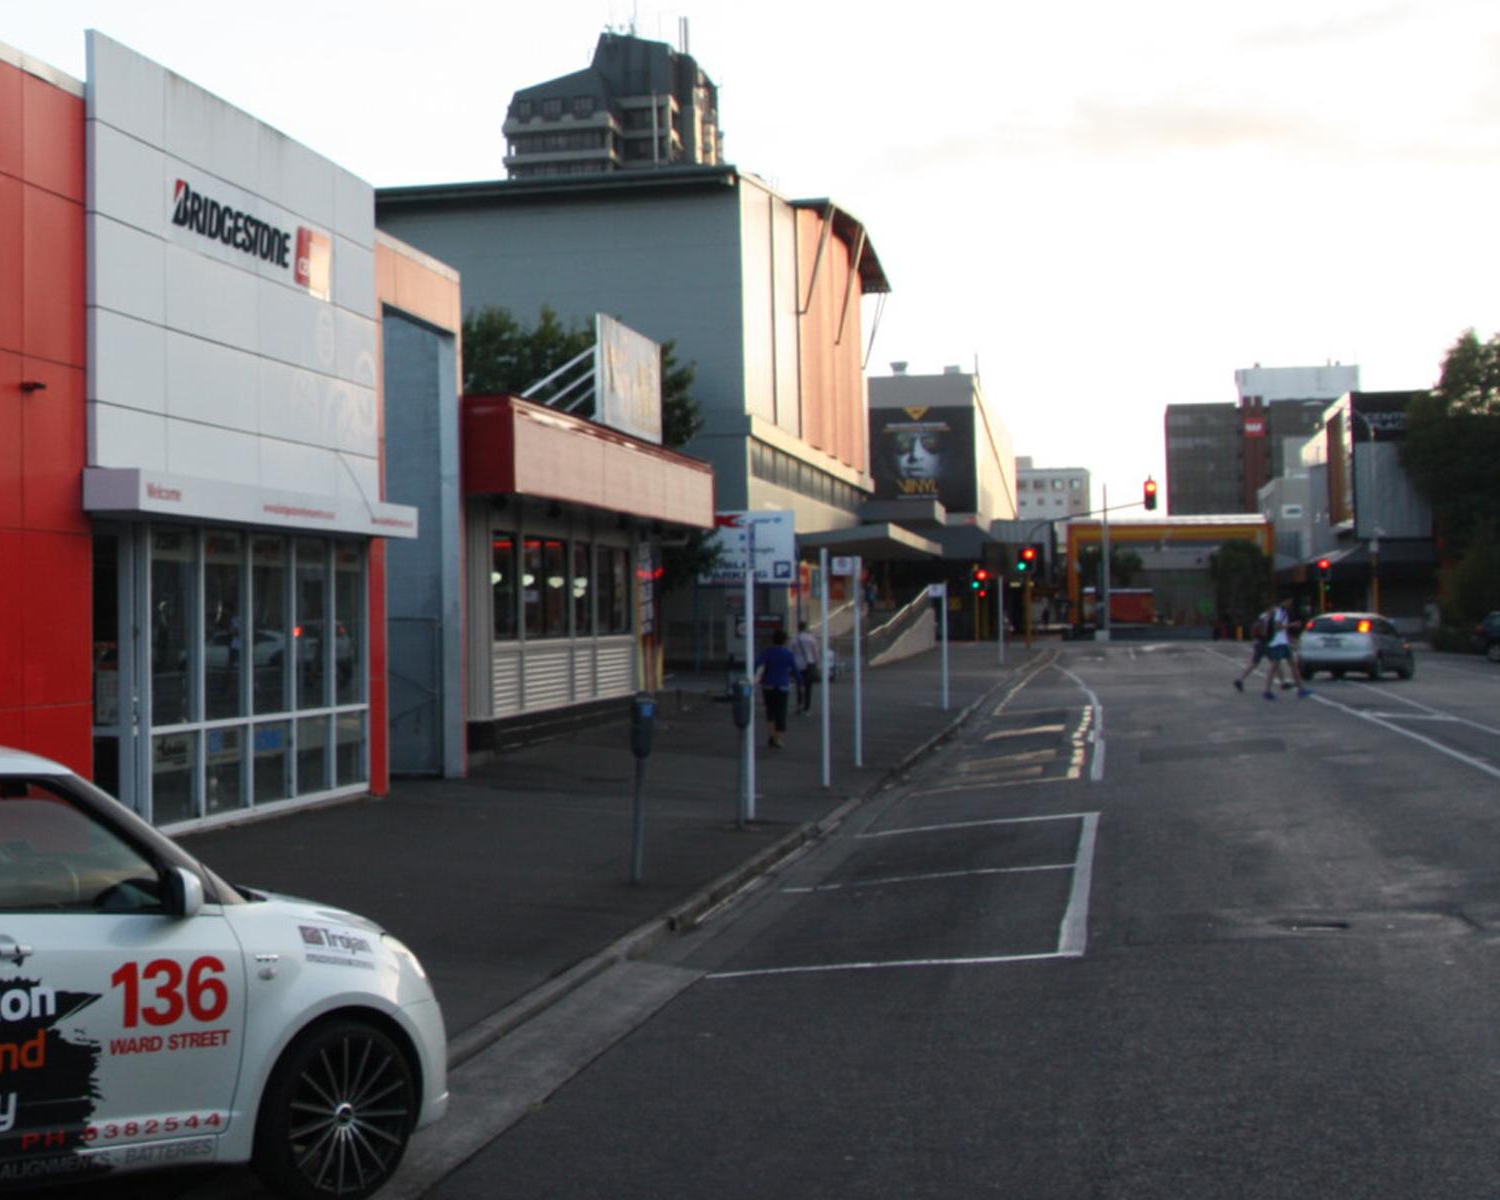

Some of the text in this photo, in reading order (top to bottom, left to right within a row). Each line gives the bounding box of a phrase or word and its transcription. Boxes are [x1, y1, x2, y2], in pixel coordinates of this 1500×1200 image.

[172, 179, 291, 268] BRIDGESTONE
[897, 479, 939, 493] VINYL
[321, 929, 373, 955] Trojan
[111, 956, 230, 1029] 136
[109, 1030, 231, 1056] WARD STREET
[21, 1130, 66, 1152] PH
[0, 1151, 111, 1179] ALIGNMENTS
[125, 1137, 214, 1163] BATTERIES
